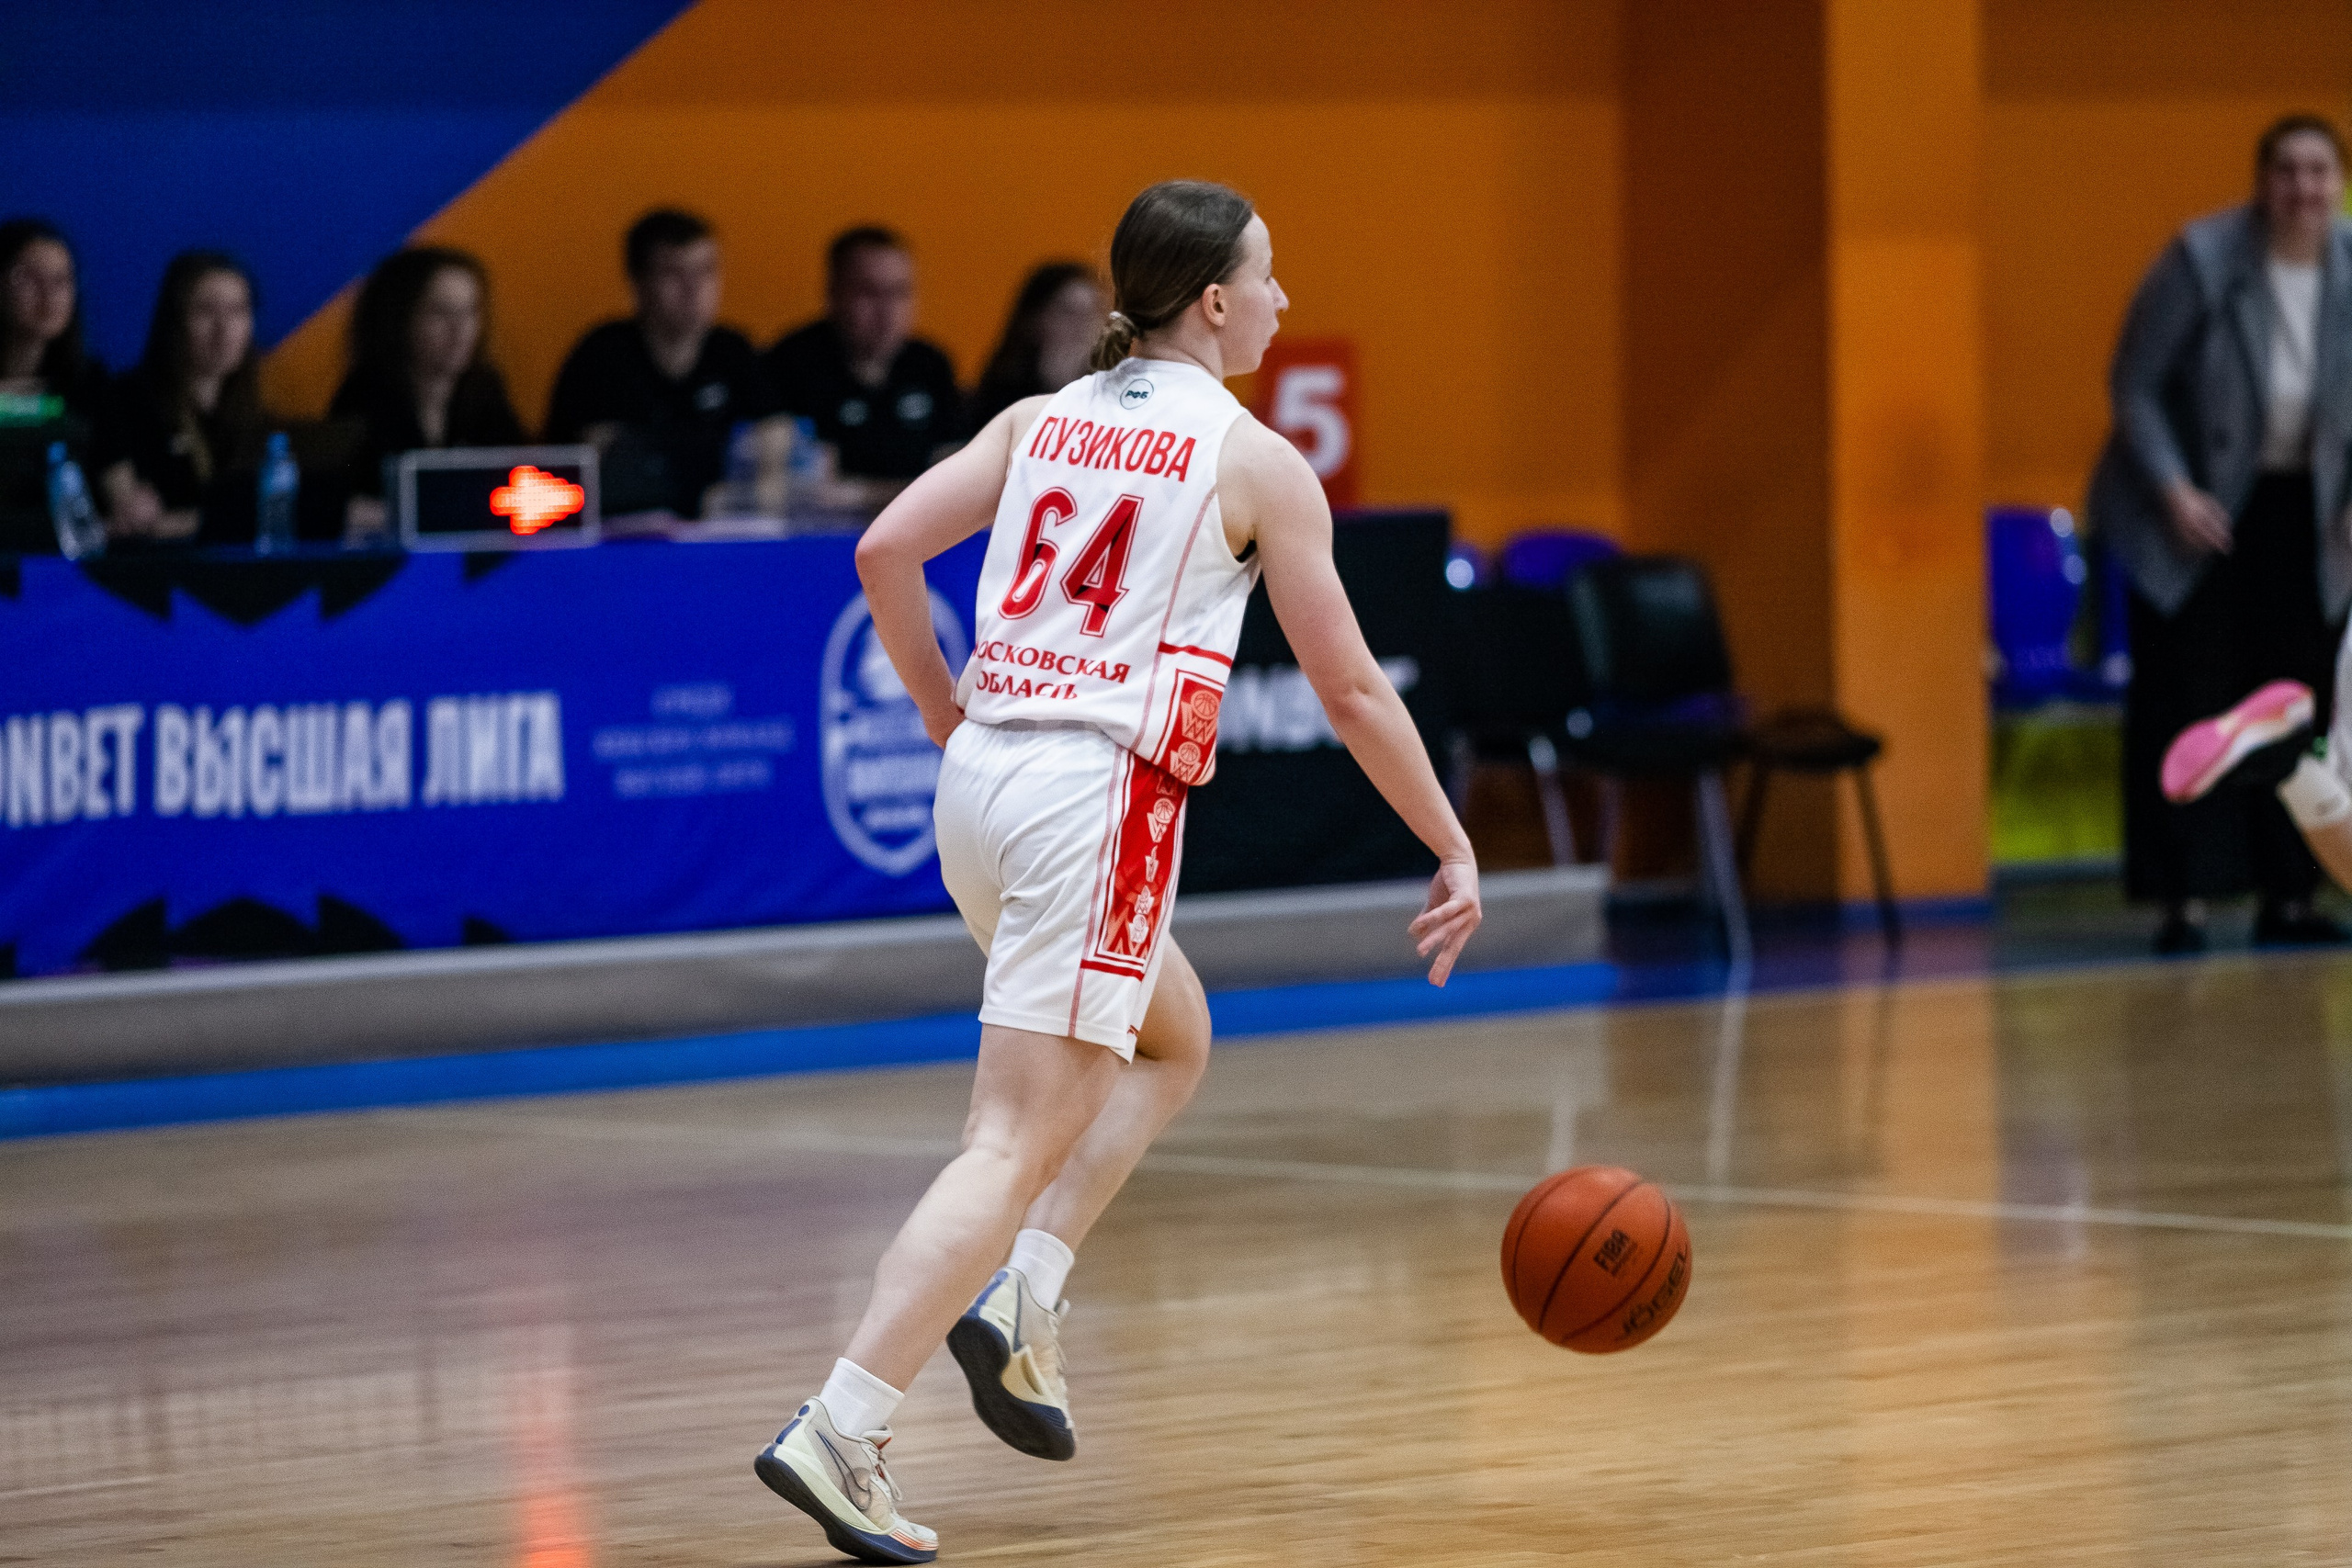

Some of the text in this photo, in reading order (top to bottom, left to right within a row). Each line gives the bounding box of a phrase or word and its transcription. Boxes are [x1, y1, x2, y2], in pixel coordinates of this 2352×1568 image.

[1028, 416, 1197, 482] ПУЗИКОВА
[1273, 365, 1351, 479] 5
[998, 486, 1145, 637] 64
[976, 671, 1078, 700] ОБЛАСТЬ
[0, 702, 145, 829] NBET
[153, 698, 413, 819] ВЫСШАЯ
[423, 689, 565, 807] ЛИГА
[1593, 1229, 1631, 1270] FIBA
